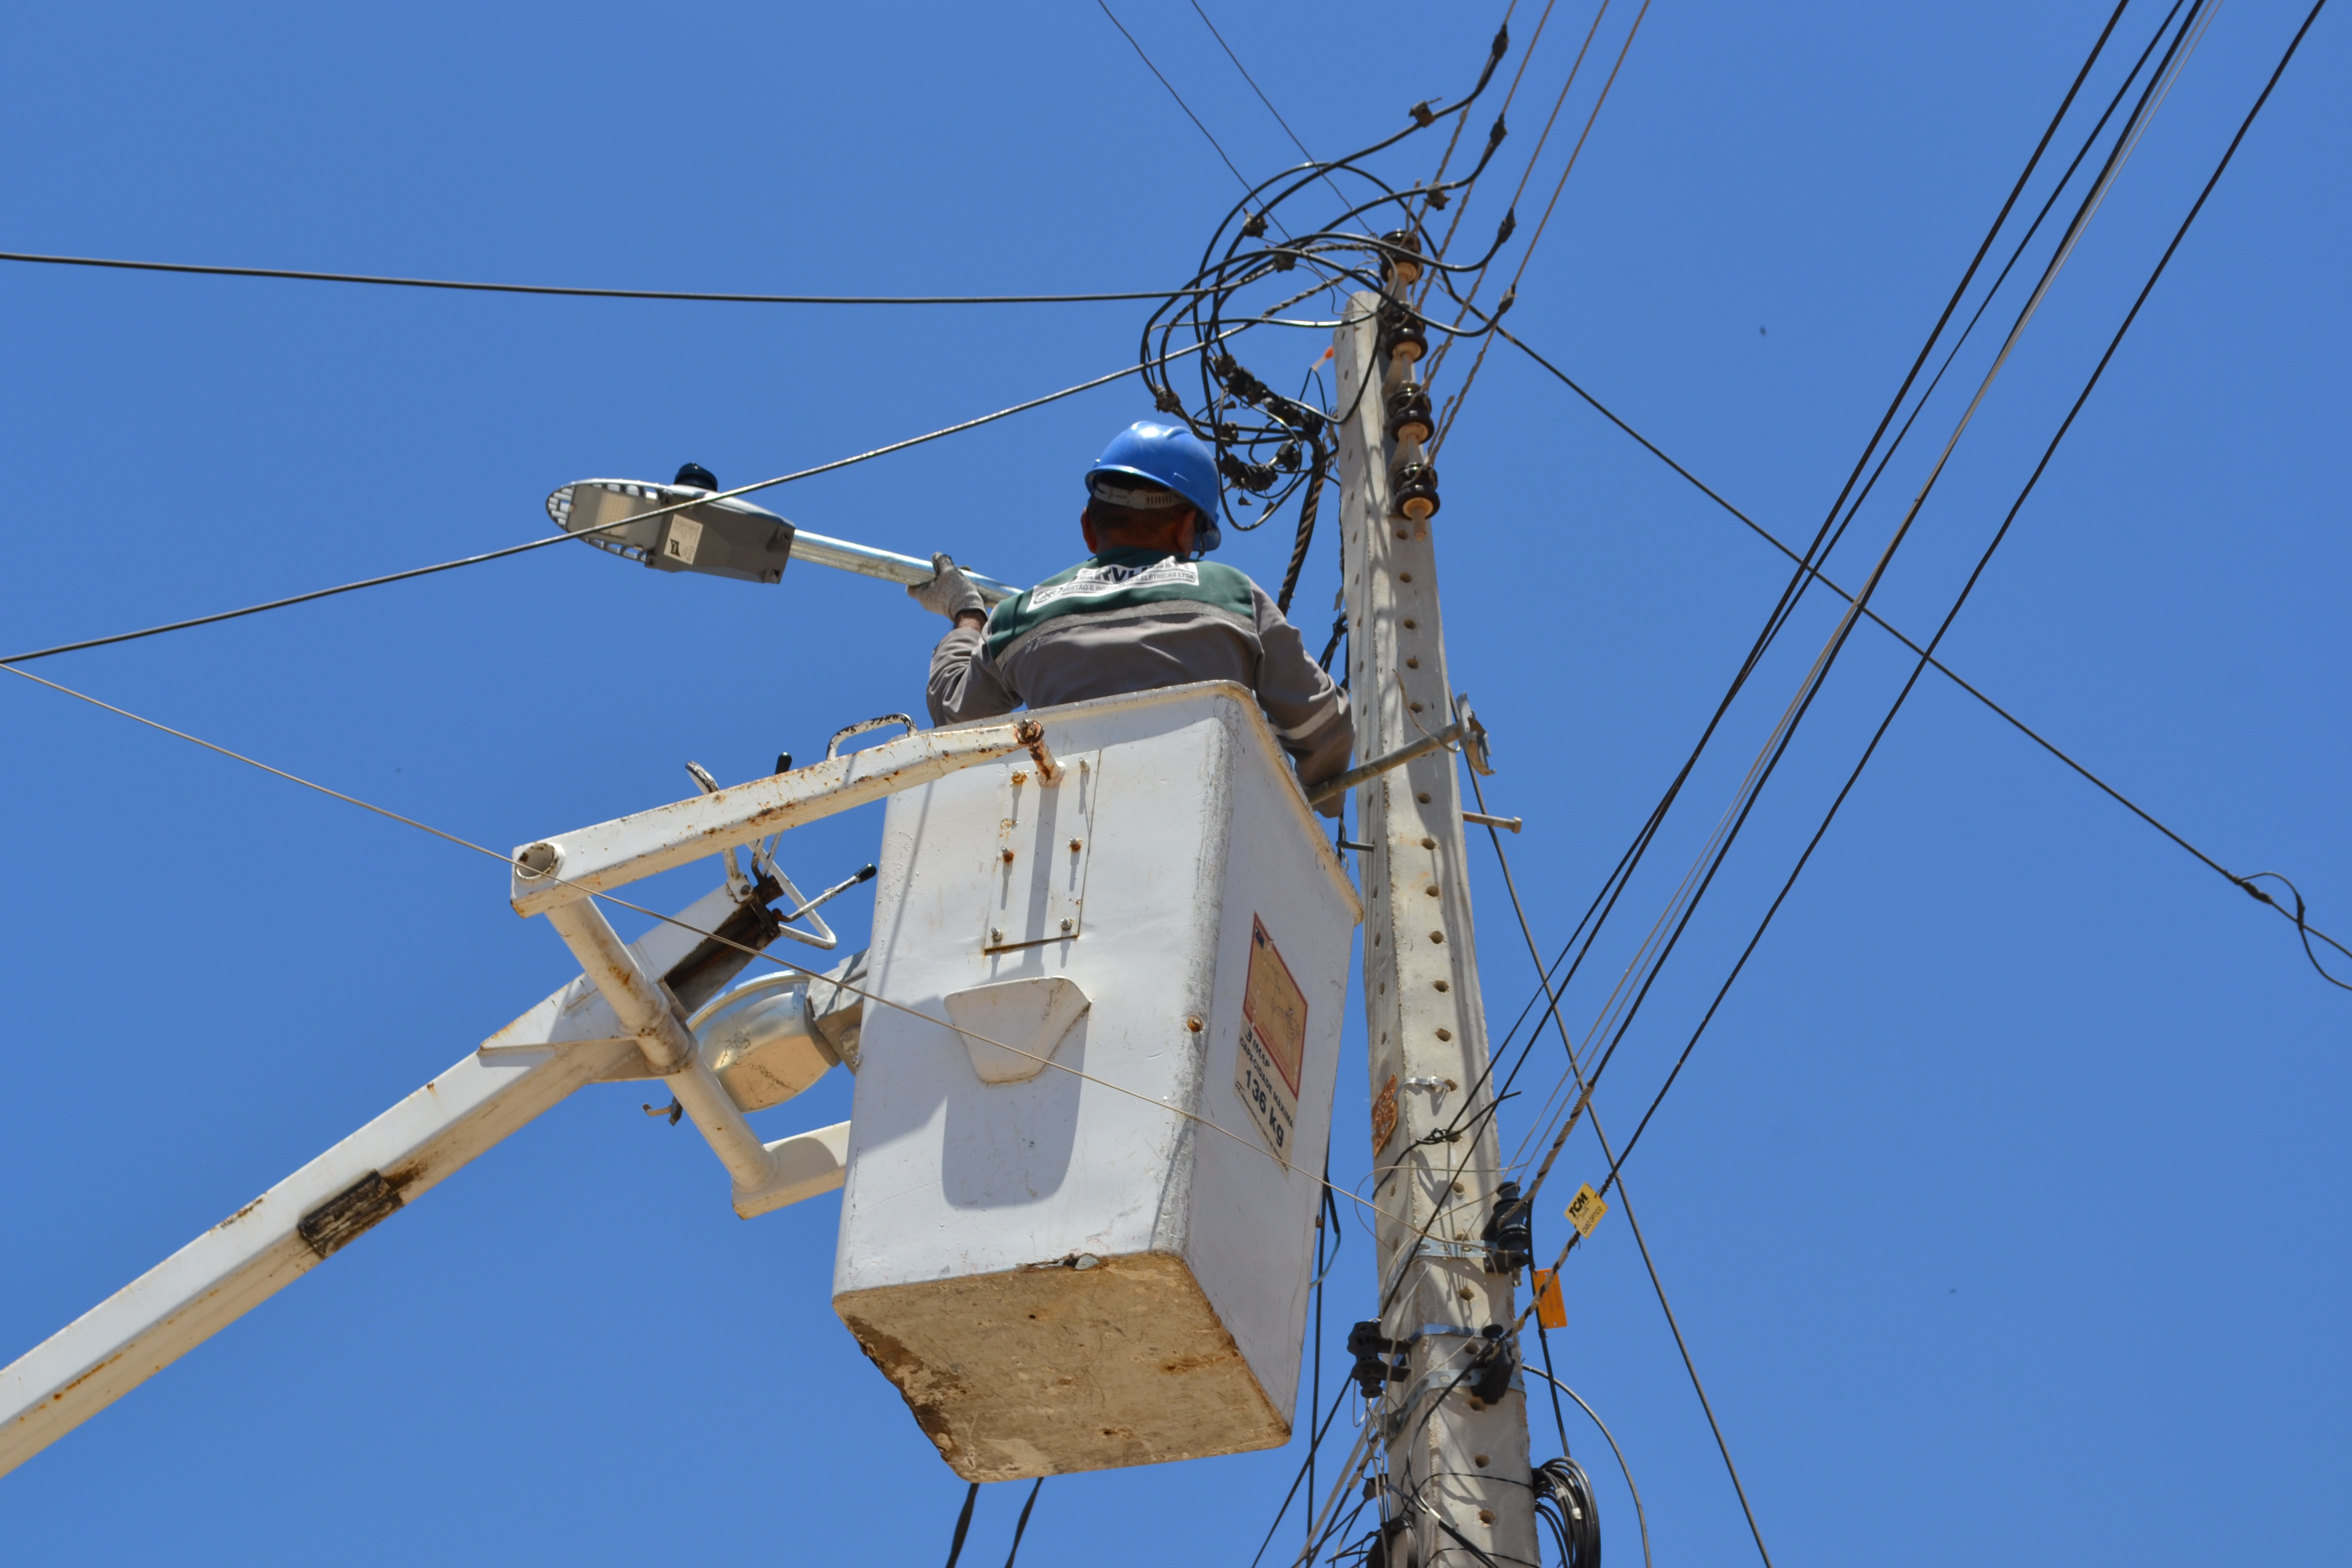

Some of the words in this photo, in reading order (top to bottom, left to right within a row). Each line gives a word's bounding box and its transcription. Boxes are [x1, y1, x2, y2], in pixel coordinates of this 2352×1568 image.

[1141, 572, 1177, 581] ELÉTRICAS
[1240, 1037, 1272, 1094] CAPACIDADE
[1273, 1091, 1293, 1130] MÁXIMA
[1246, 1069, 1267, 1114] 136
[1269, 1106, 1284, 1148] kg
[1569, 1191, 1588, 1218] TCM
